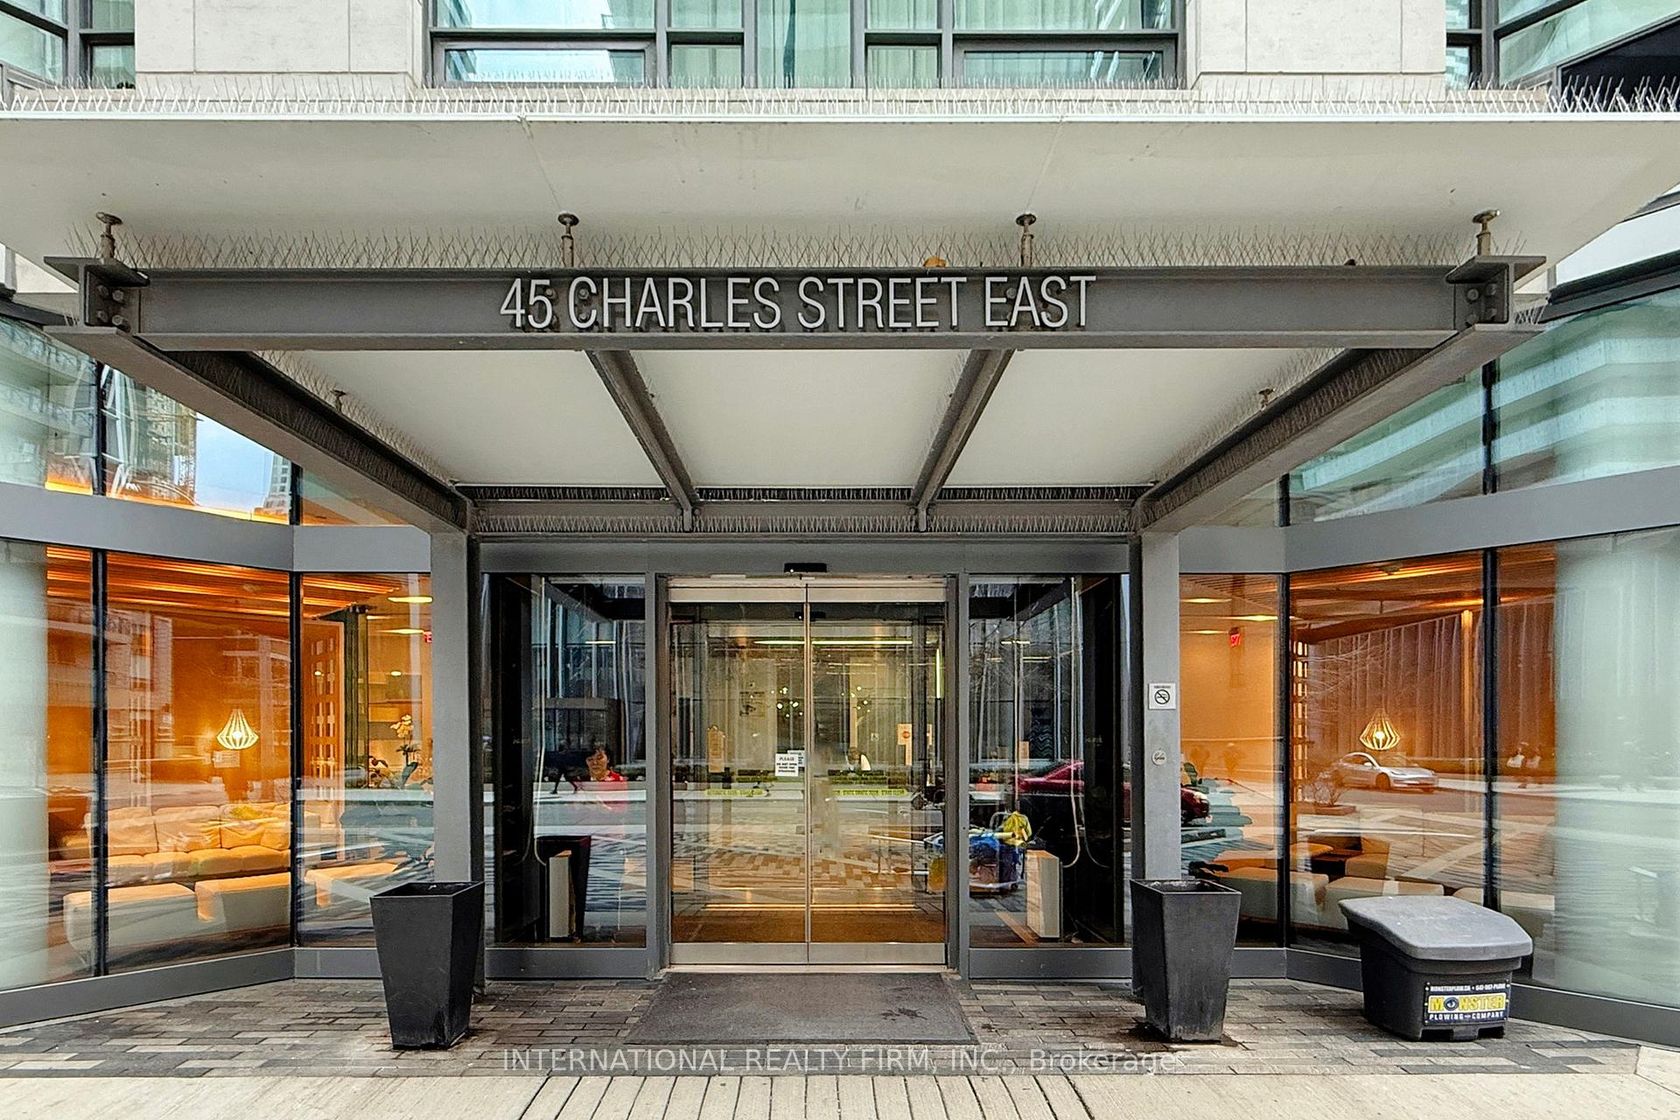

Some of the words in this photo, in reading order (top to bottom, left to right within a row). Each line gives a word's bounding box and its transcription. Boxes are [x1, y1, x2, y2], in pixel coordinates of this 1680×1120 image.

[500, 278, 553, 329] 45
[568, 276, 782, 329] CHARLES
[798, 276, 967, 329] STREET
[985, 275, 1097, 328] EAST
[1429, 995, 1505, 1011] MONSTER
